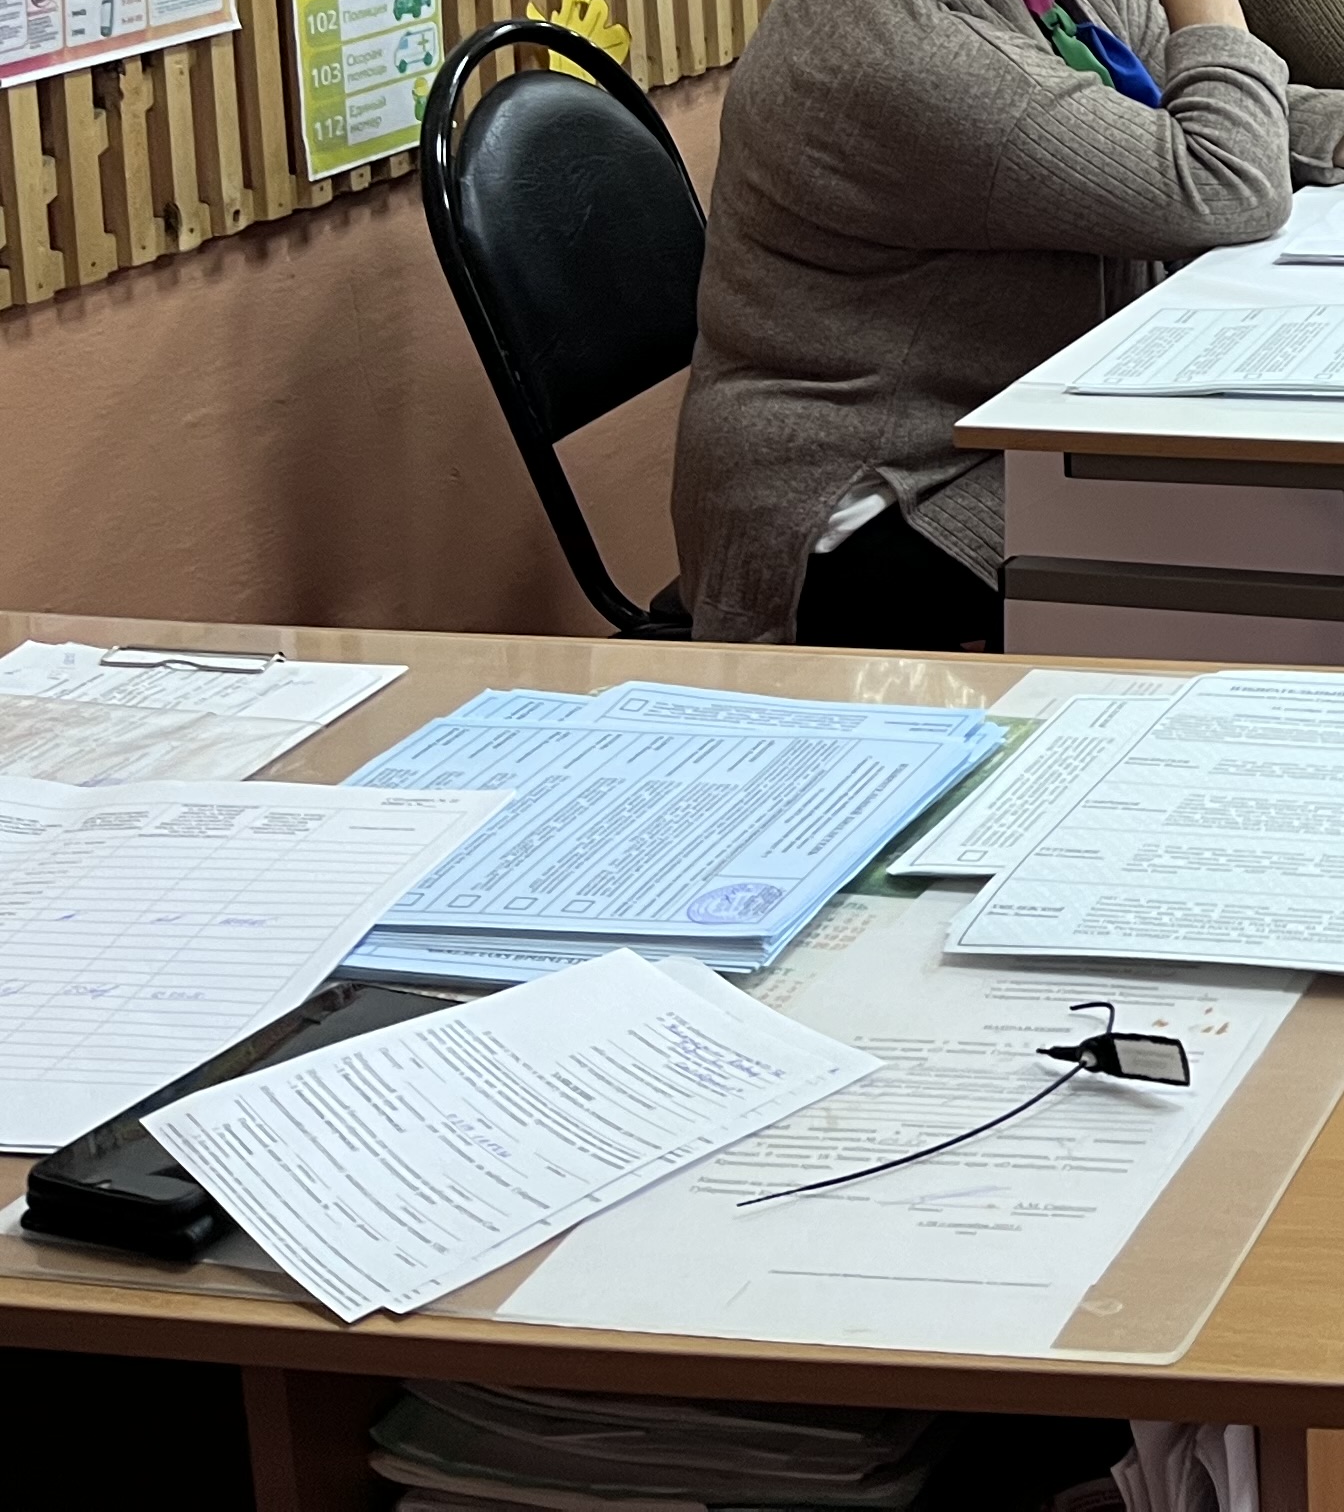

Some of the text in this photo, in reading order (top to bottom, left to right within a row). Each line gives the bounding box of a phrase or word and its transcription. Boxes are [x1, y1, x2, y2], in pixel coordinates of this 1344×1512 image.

[307, 3, 388, 35] 102 Полиция
[311, 48, 384, 89] 103 Скорая
[314, 114, 345, 141] 112
